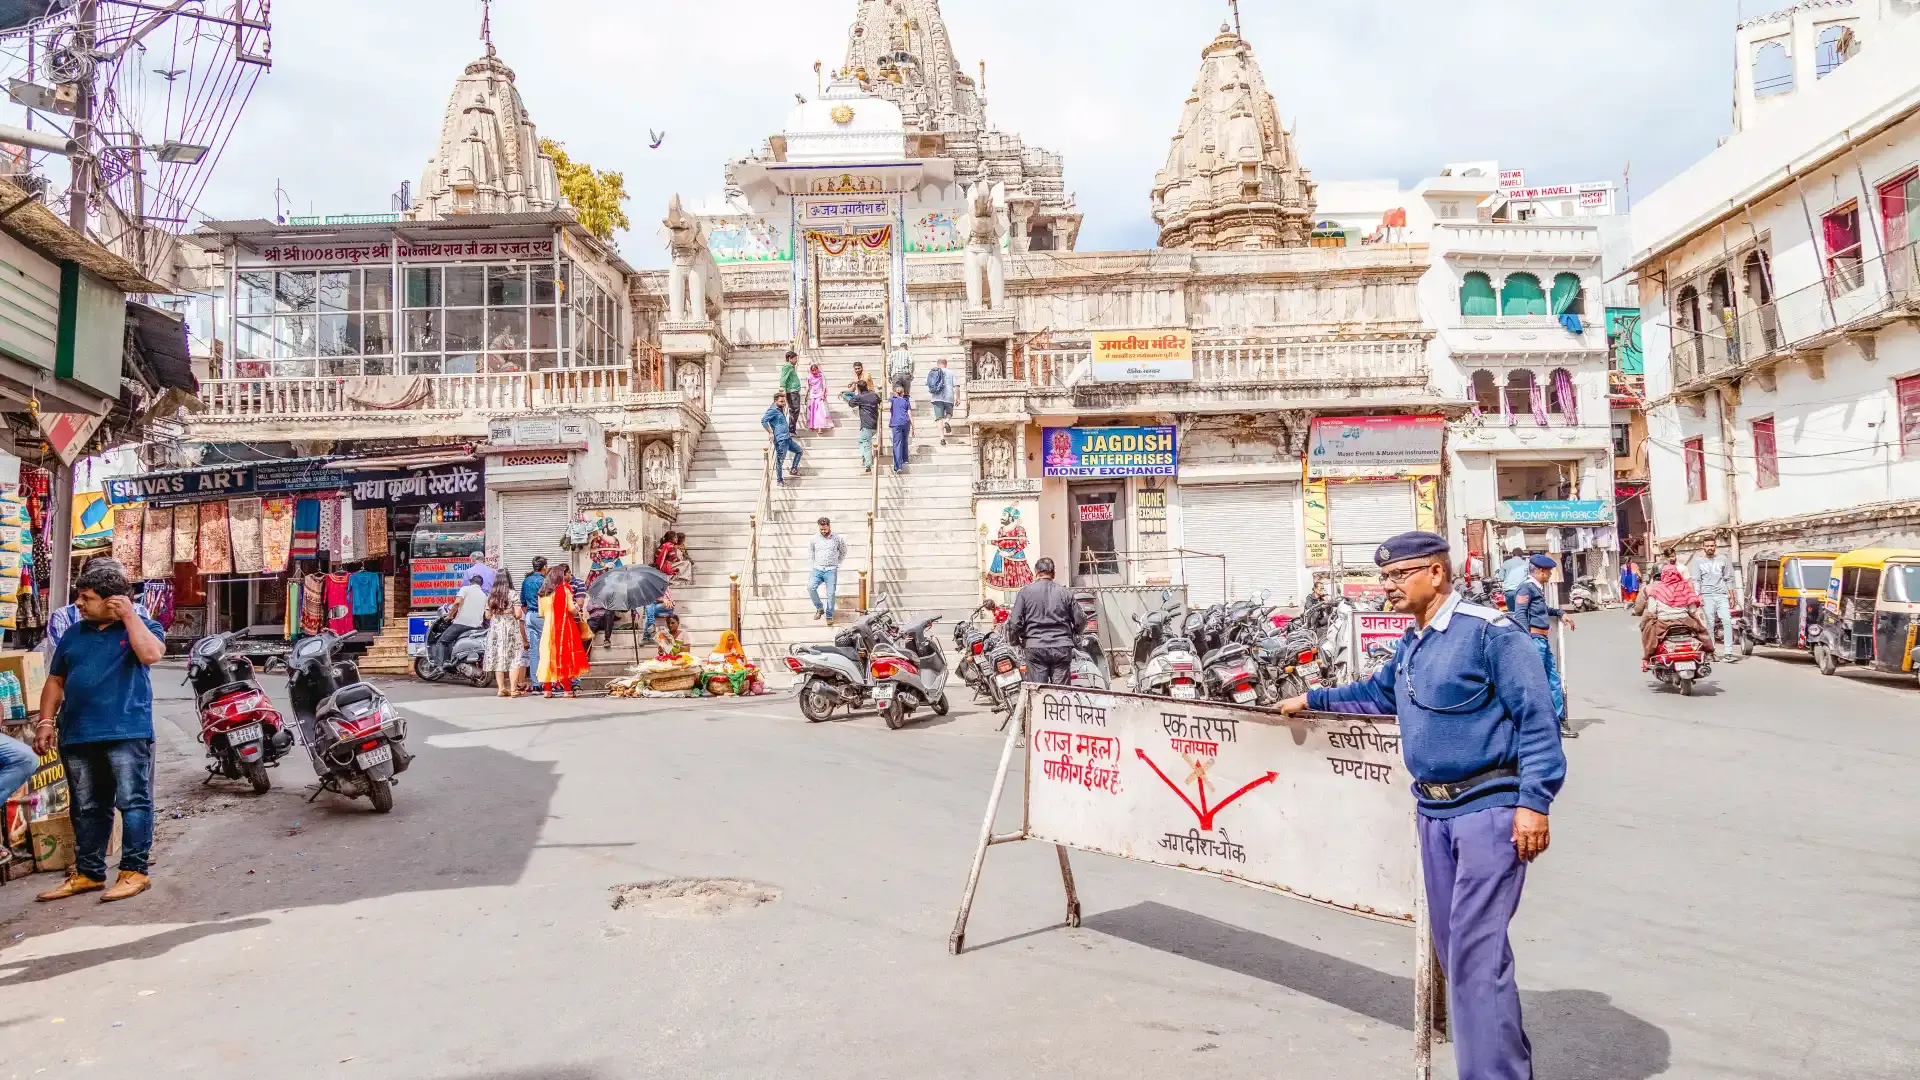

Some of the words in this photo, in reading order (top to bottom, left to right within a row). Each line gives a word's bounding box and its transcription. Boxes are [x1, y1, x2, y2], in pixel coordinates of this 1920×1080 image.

[1500, 171, 1522, 179] PATWA
[1500, 179, 1522, 187] HAVELI
[1510, 190, 1539, 199] PATWA
[1541, 186, 1573, 195] HAVELI
[820, 205, 839, 216] जय
[840, 201, 873, 215] जगदीश
[875, 200, 887, 213] हरे
[264, 246, 281, 261] श्री
[283, 245, 300, 261] श्री
[302, 248, 334, 261] 1008
[335, 247, 370, 262] ठाकुर
[372, 243, 389, 258] श्री
[391, 243, 442, 257] गन्नाथ
[444, 243, 463, 257] राय
[465, 240, 478, 256] जी
[480, 242, 497, 255] का
[500, 241, 530, 254] रजत
[533, 240, 553, 254] रथ
[1098, 335, 1149, 351] जगदीश
[1151, 334, 1187, 350] मंदिर
[1081, 434, 1173, 453] JAGDISH
[1081, 453, 1173, 466] ENTERPRISES
[1047, 467, 1095, 476] MONEY
[1100, 467, 1173, 475] EXCHANGE
[112, 475, 184, 498] SHIVA'S
[198, 471, 248, 491] ART
[353, 479, 385, 500] राधा
[1138, 492, 1165, 507] MONEY
[1080, 504, 1111, 513] MONEY
[1080, 512, 1113, 520] EXCHANGE
[1514, 511, 1559, 520] BOMBAY
[1561, 510, 1598, 520] FABRICS
[1042, 693, 1073, 722] सिटी
[1074, 692, 1107, 727] पैलेस
[1170, 737, 1219, 757] यातायात
[31, 763, 65, 791] TATTOO
[1326, 756, 1392, 785] घण्टाघर
